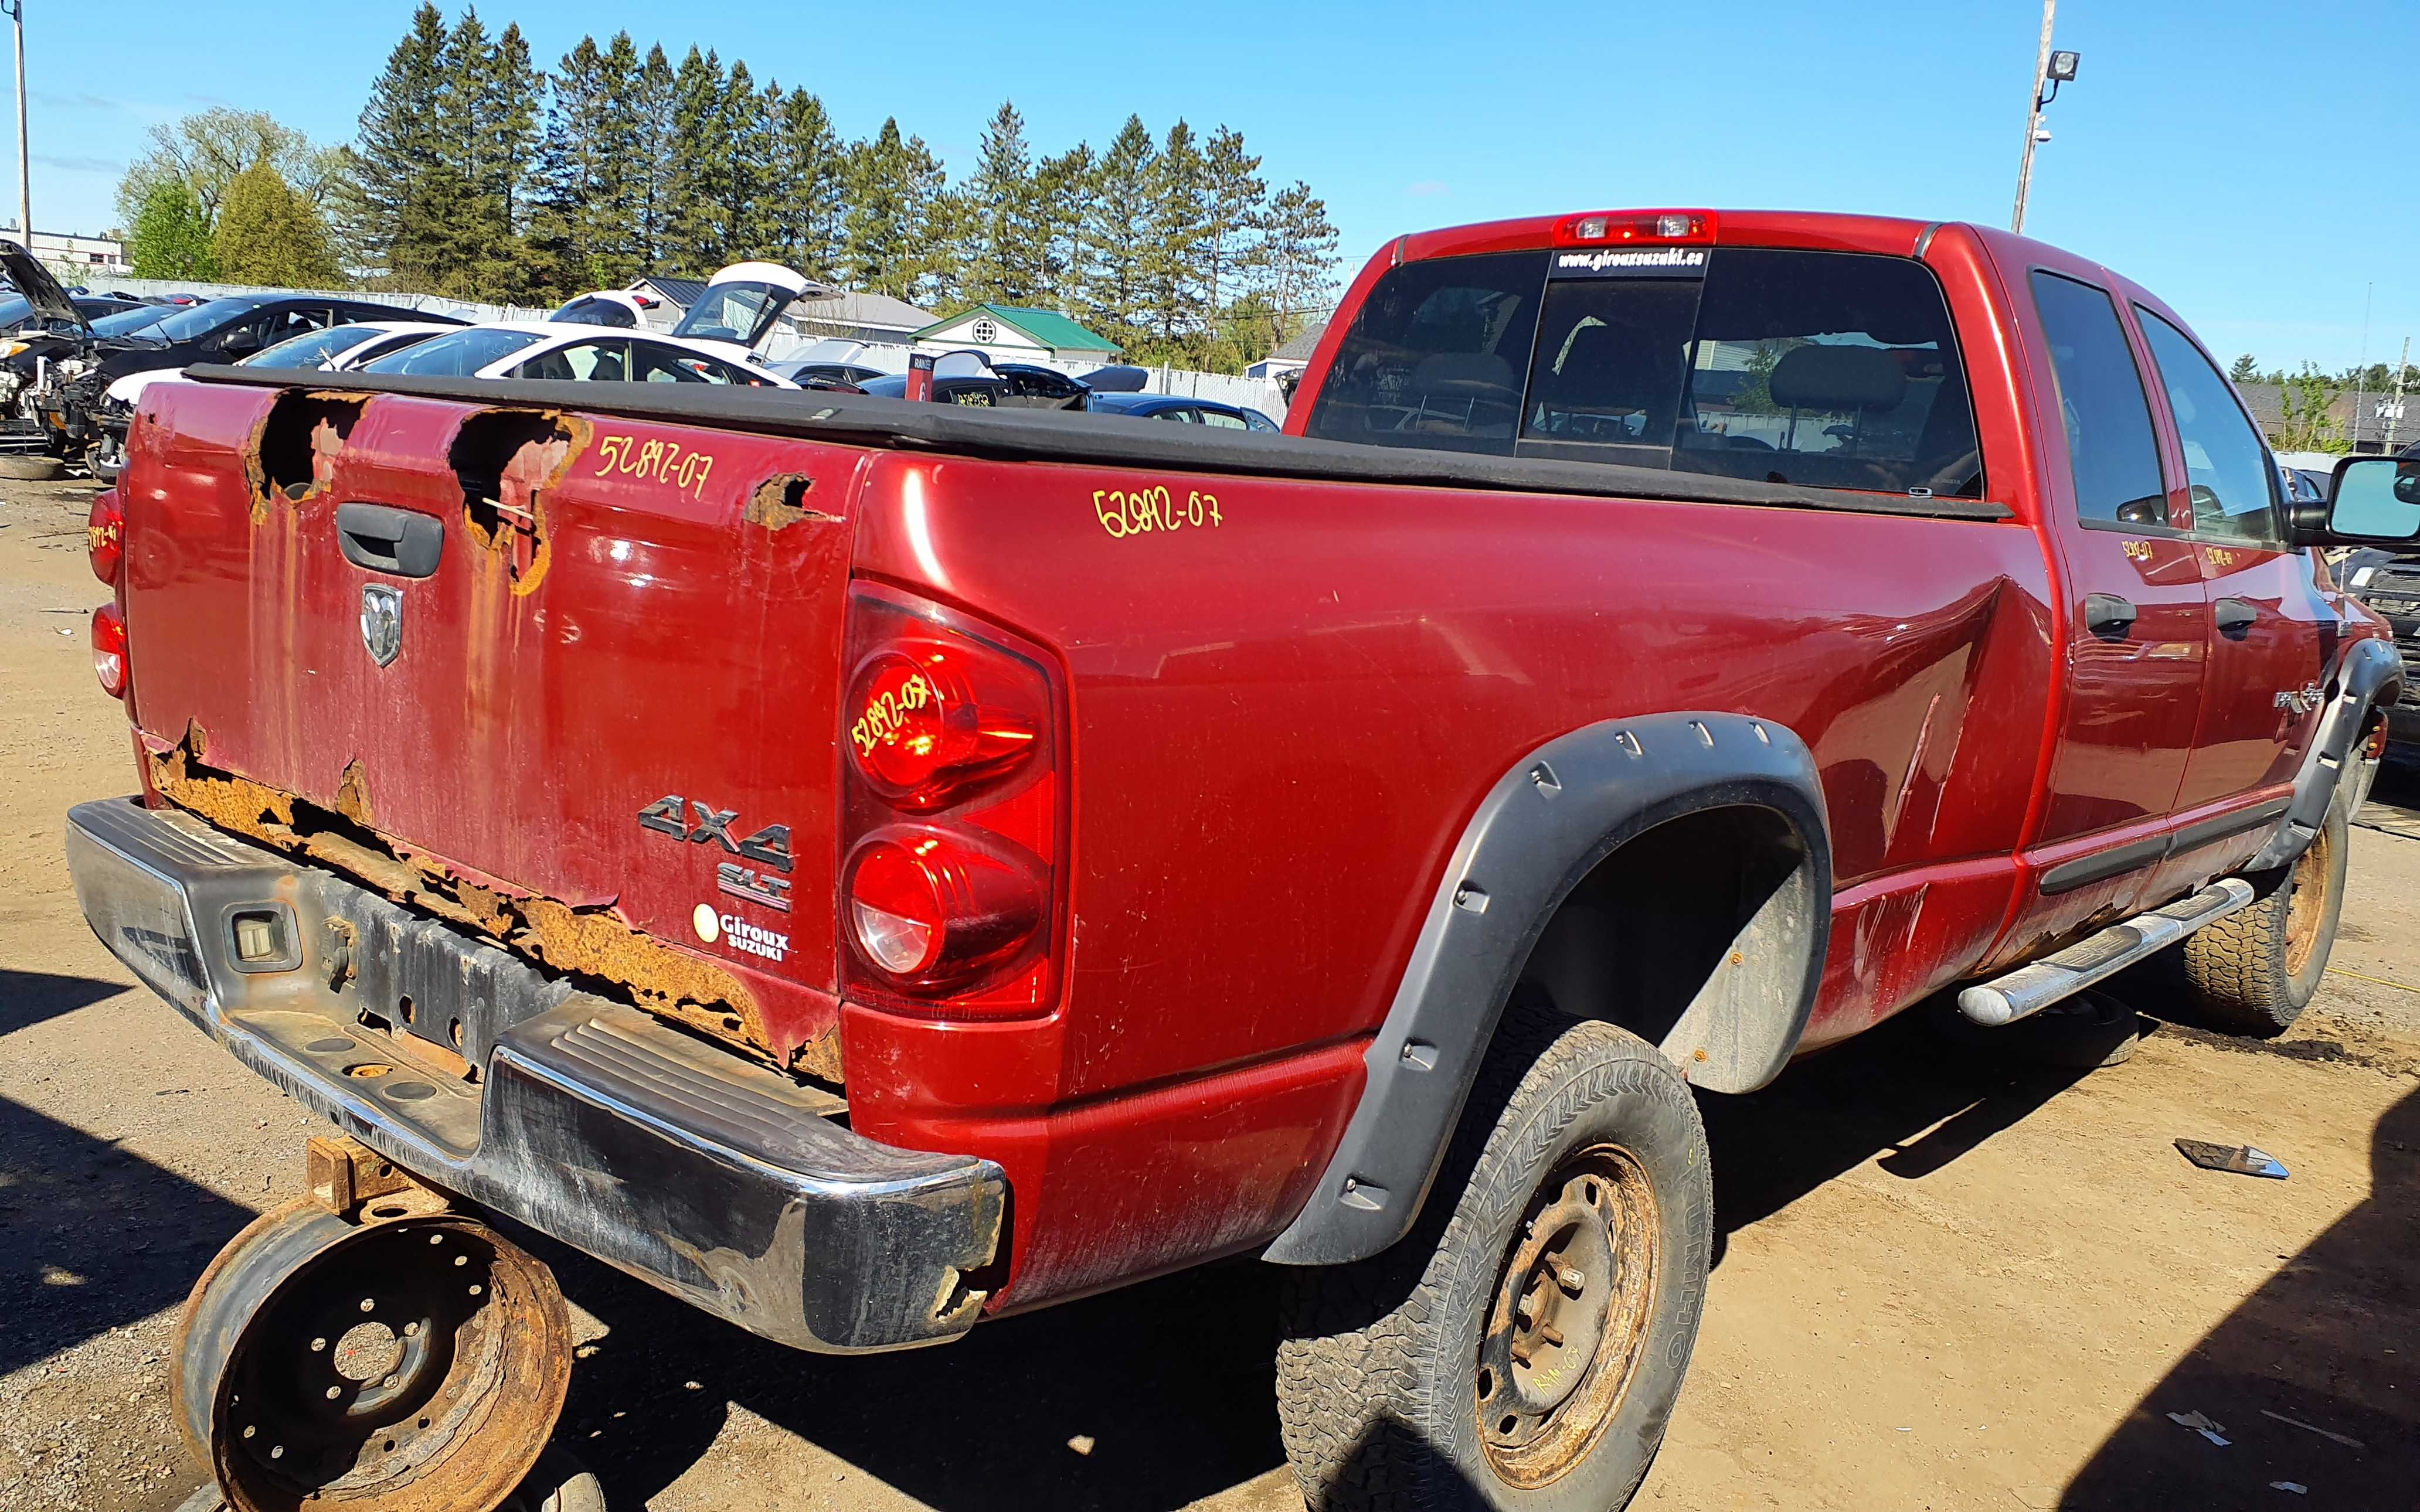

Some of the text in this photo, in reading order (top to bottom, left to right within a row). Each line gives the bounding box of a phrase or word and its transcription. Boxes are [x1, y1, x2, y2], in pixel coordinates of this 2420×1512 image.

[1559, 247, 1704, 271] www.girouxsuzuki.ca
[919, 382, 926, 401] 6
[594, 436, 713, 500] 52892-07
[1092, 485, 1223, 538] 52892-07
[851, 674, 932, 757] 52892-07
[720, 914, 789, 950] Giroux
[728, 934, 783, 962] SUZUKI
[1666, 1167, 1702, 1369] KUMHO
